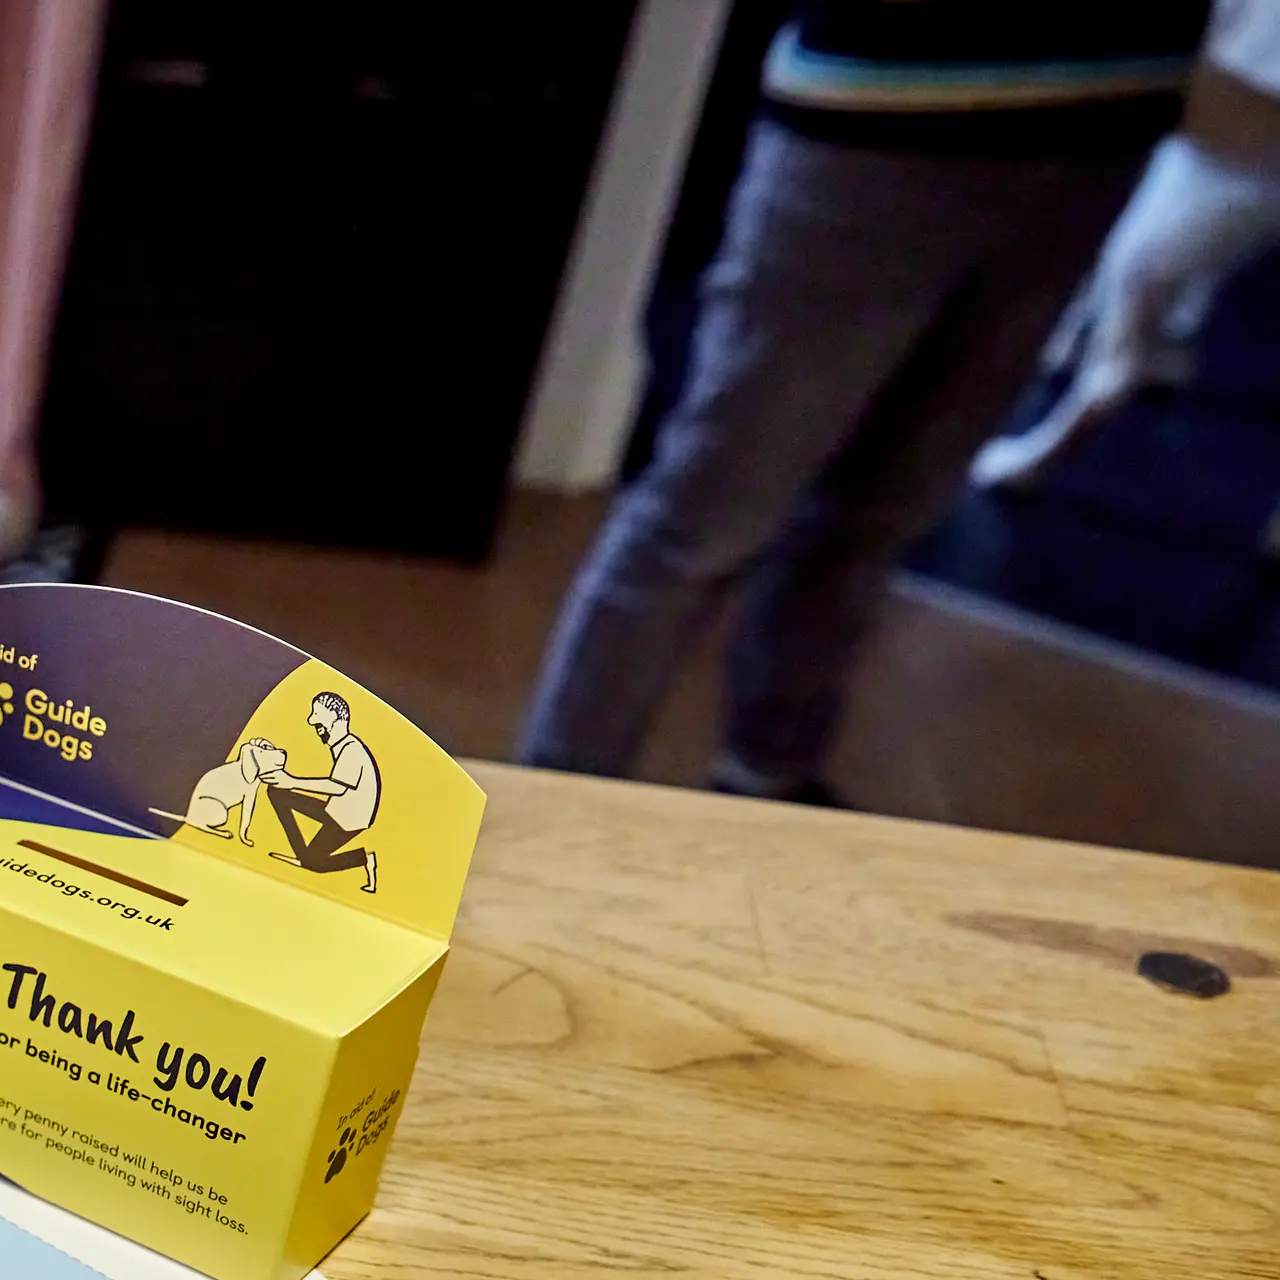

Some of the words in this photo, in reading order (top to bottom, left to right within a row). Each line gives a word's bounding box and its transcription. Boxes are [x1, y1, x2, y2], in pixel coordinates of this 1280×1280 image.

[18, 654, 38, 671] of
[25, 689, 107, 736] Guide
[23, 714, 93, 761] Dogs
[2, 963, 144, 1064] Thank
[153, 1041, 267, 1111] you!
[25, 1039, 81, 1081] being
[88, 1070, 101, 1084] a
[107, 1072, 246, 1145] life-changer
[363, 1090, 400, 1132] Guide
[24, 1105, 69, 1137] penny
[72, 1128, 119, 1158] raised
[122, 1151, 147, 1170] will
[150, 1160, 183, 1188] help
[187, 1180, 204, 1196] us
[208, 1188, 228, 1206] be
[356, 1116, 389, 1156] Dogs
[21, 1123, 43, 1141] for
[45, 1138, 95, 1169] people
[99, 1156, 136, 1187] living
[140, 1178, 170, 1200] with
[174, 1192, 213, 1221] sight
[215, 1208, 249, 1235] loss.
